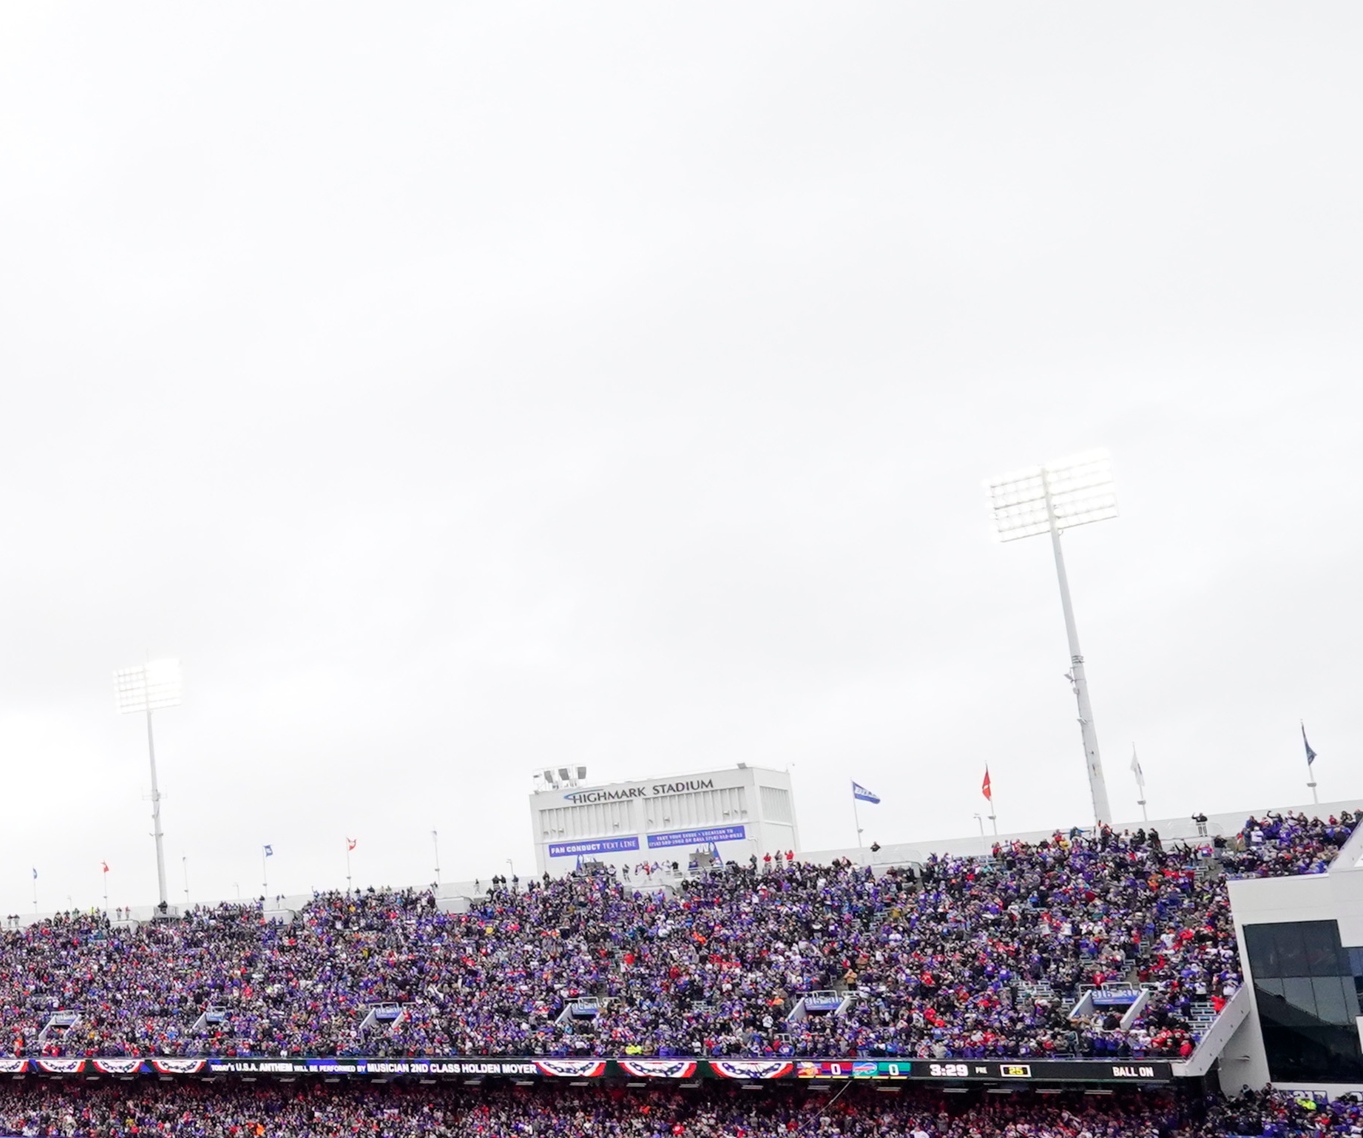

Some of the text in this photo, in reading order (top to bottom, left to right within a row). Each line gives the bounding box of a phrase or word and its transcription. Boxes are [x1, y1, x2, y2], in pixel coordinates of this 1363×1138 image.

[573, 778, 714, 804] HIGHMARK STADIUM
[551, 846, 565, 855] FAN
[566, 843, 600, 853] CONDUCT
[602, 841, 619, 850] TEXT
[236, 1063, 258, 1072] U.S.A.
[259, 1063, 293, 1072] ANTHEM
[319, 1065, 357, 1073] PERFORMED
[357, 1065, 367, 1073] BY
[367, 1063, 409, 1073] MUSICIAN
[410, 1063, 429, 1073] 2ND
[429, 1063, 462, 1073] CLASS
[462, 1063, 501, 1074] HOLDEN
[501, 1063, 538, 1074] MOYER
[830, 1064, 841, 1075] 0
[888, 1064, 900, 1076] 0
[930, 1064, 970, 1078] 3:29
[1008, 1066, 1023, 1076] 25
[1112, 1066, 1154, 1077] BALL ON
